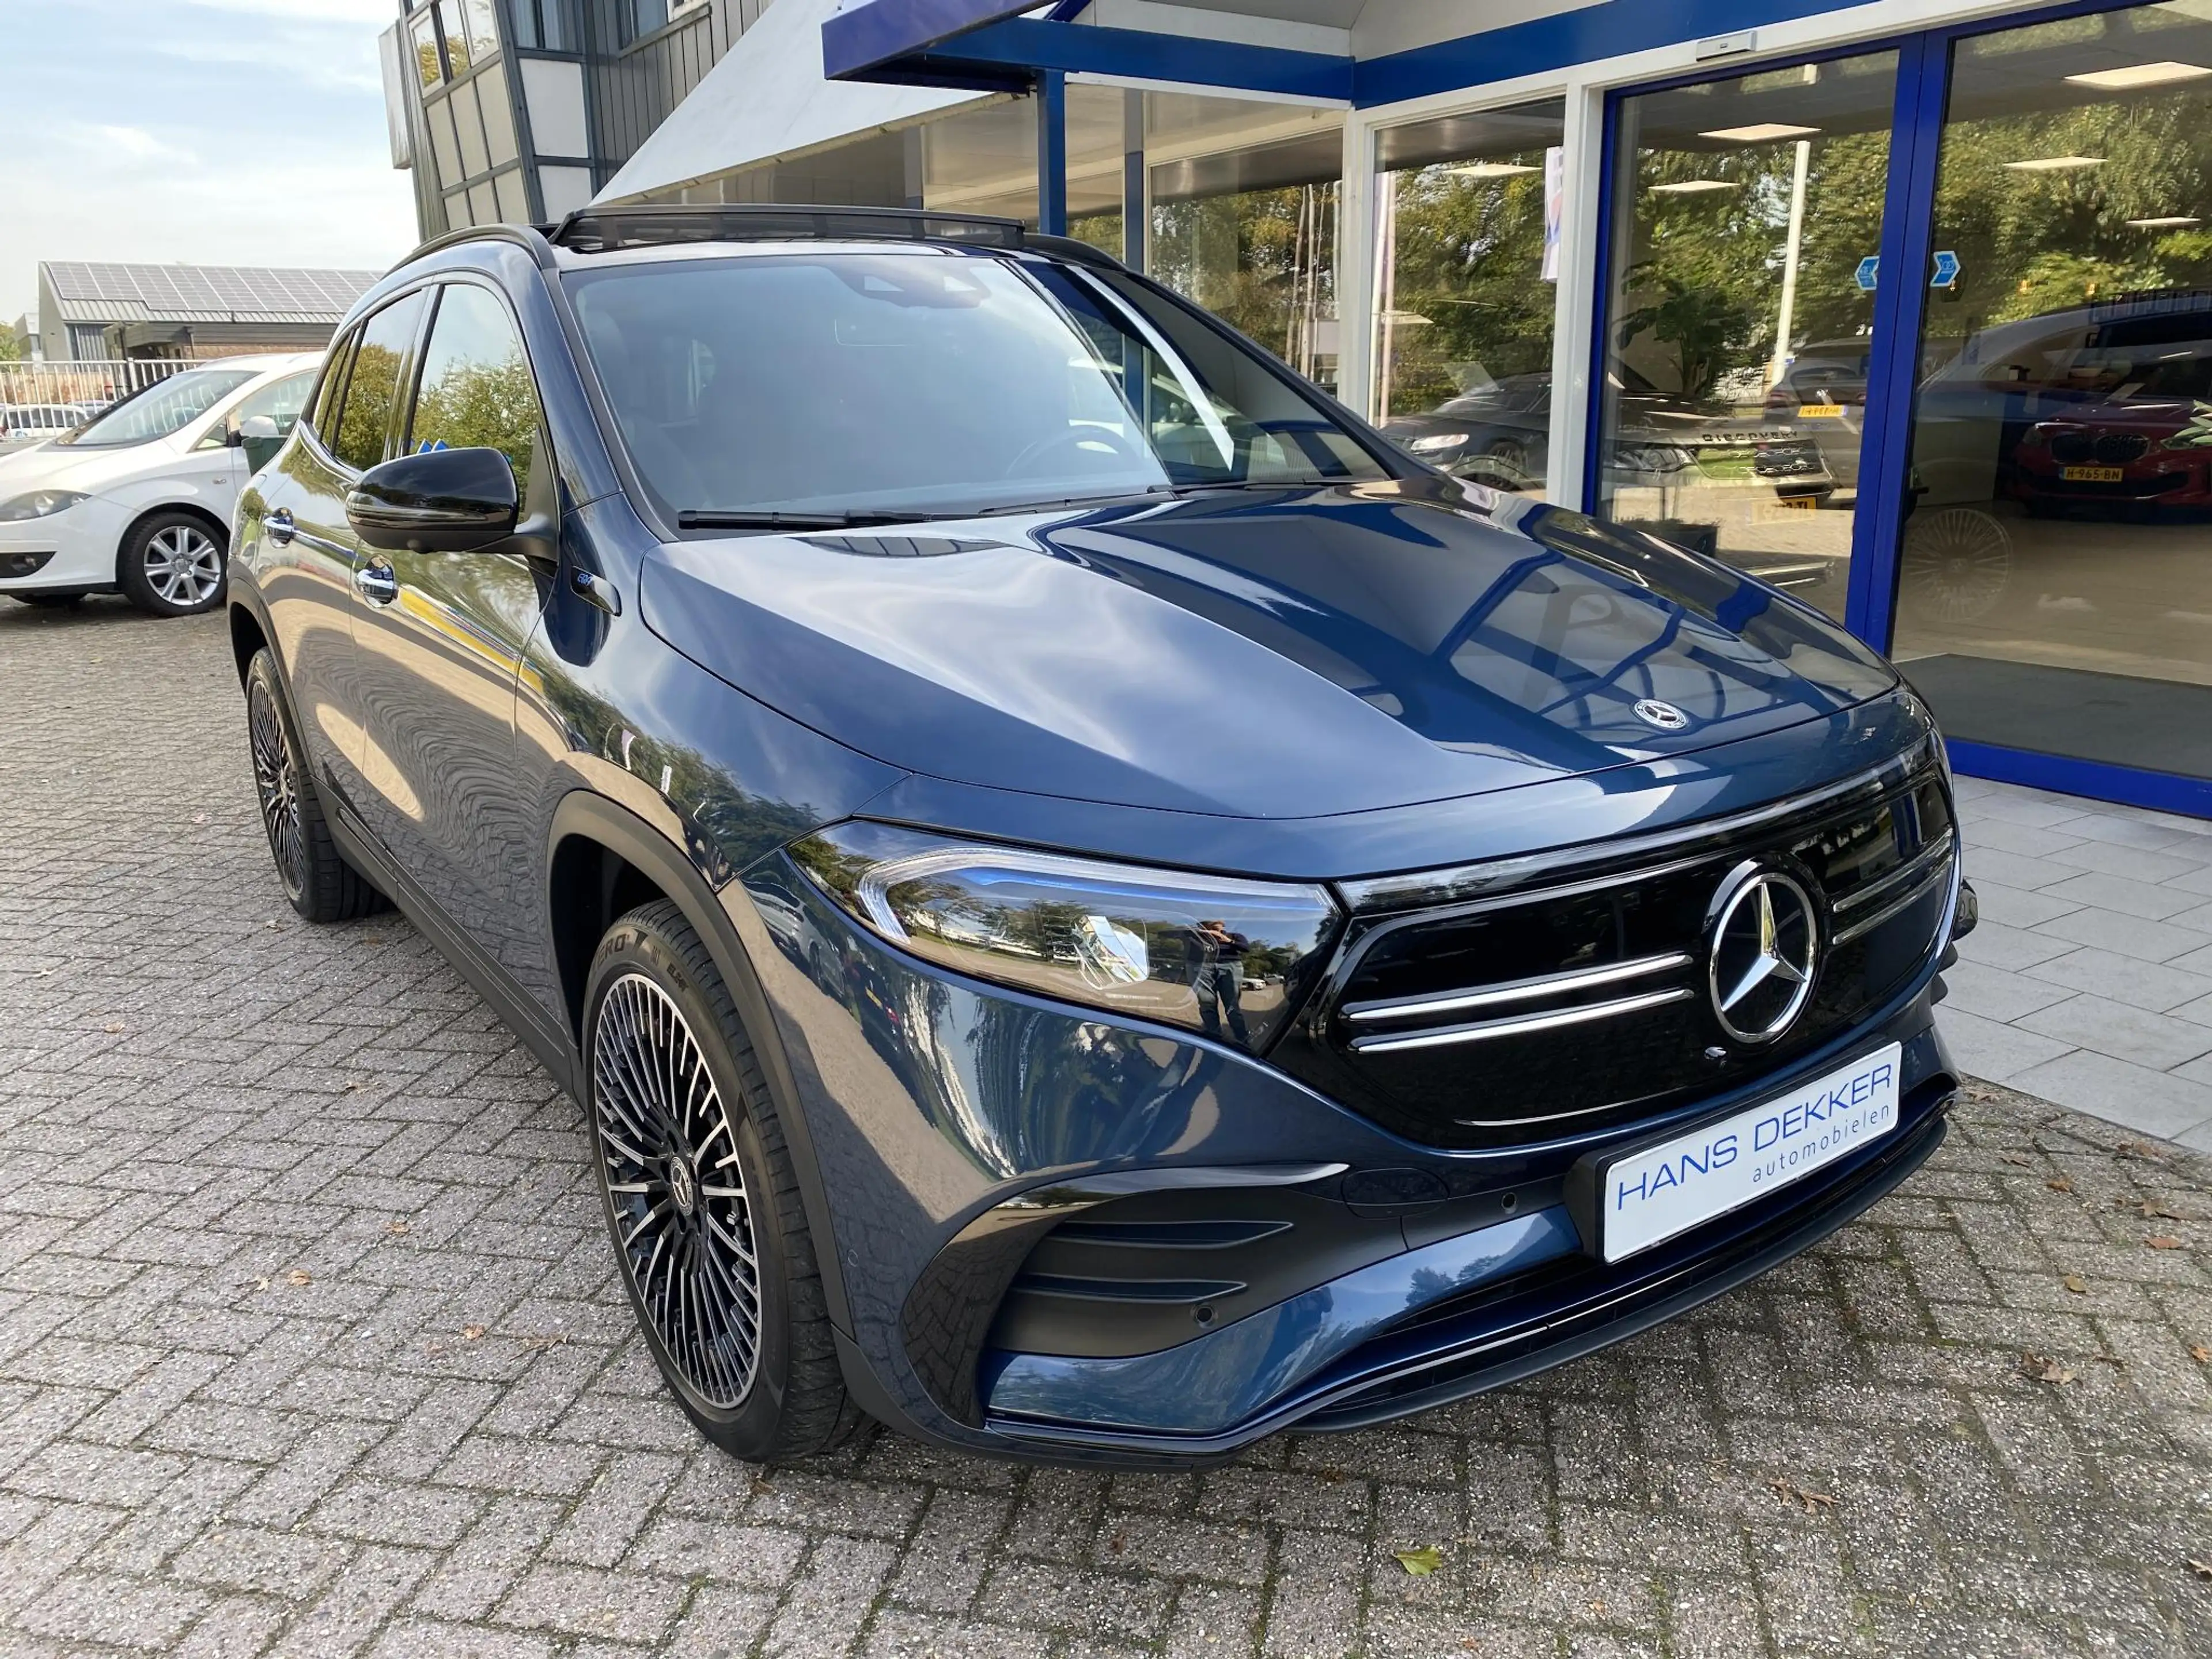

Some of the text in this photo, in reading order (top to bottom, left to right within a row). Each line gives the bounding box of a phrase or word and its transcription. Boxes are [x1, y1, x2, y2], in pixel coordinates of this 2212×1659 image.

[2066, 468, 2120, 480] H-965-BN
[1618, 1064, 1891, 1210] HANS DEKKER
[1753, 1105, 1889, 1183] automobielen
